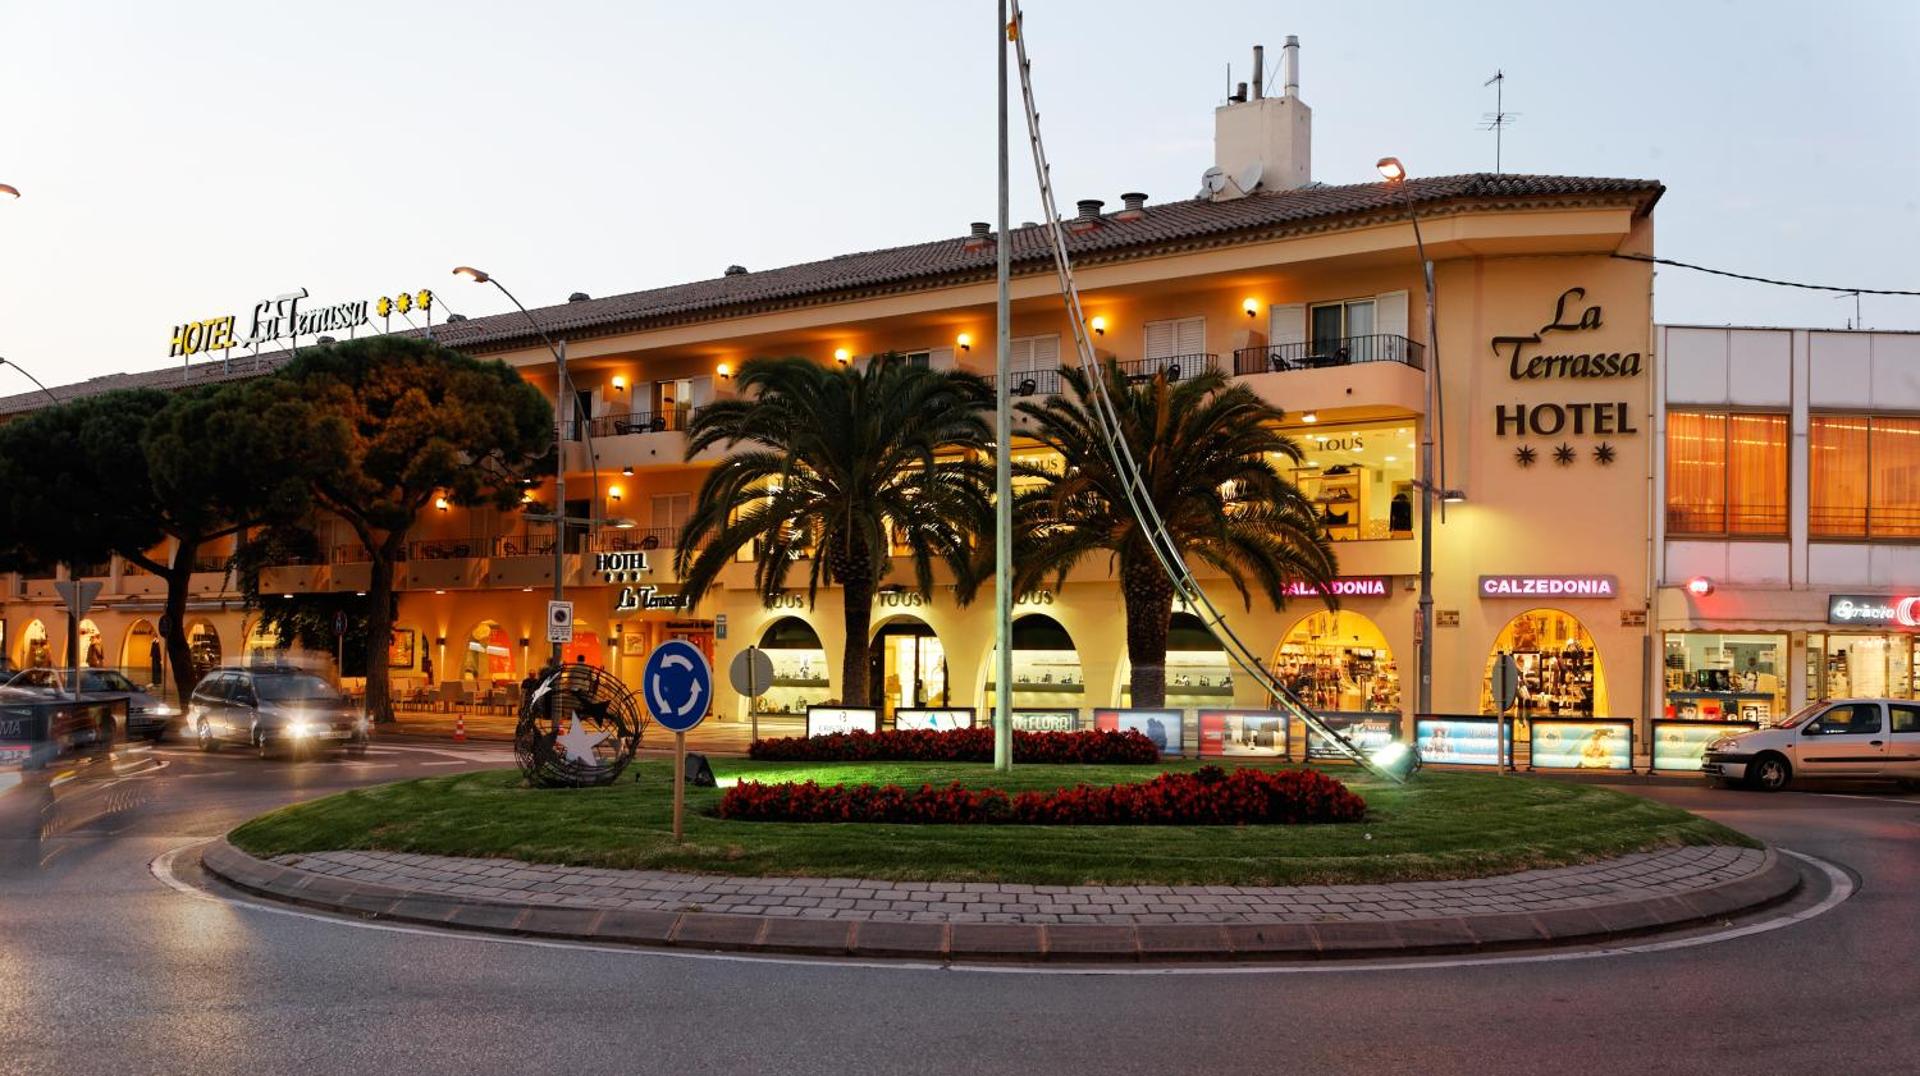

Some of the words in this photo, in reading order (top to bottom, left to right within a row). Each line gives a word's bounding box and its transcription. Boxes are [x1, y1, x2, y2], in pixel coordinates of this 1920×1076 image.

[1540, 287, 1603, 335] La
[169, 316, 238, 357] HOTEL
[242, 300, 281, 348] La
[276, 287, 369, 338] Terrassa
[1491, 332, 1642, 380] Terrassa
[1495, 402, 1637, 436] HOTEL
[1318, 437, 1364, 451] TOUS
[596, 551, 649, 571] HOTEL
[1281, 580, 1386, 595] ALDONIA
[1484, 579, 1612, 594] CALZEDONIA
[768, 593, 804, 608] OUS
[879, 591, 922, 607] TOUS
